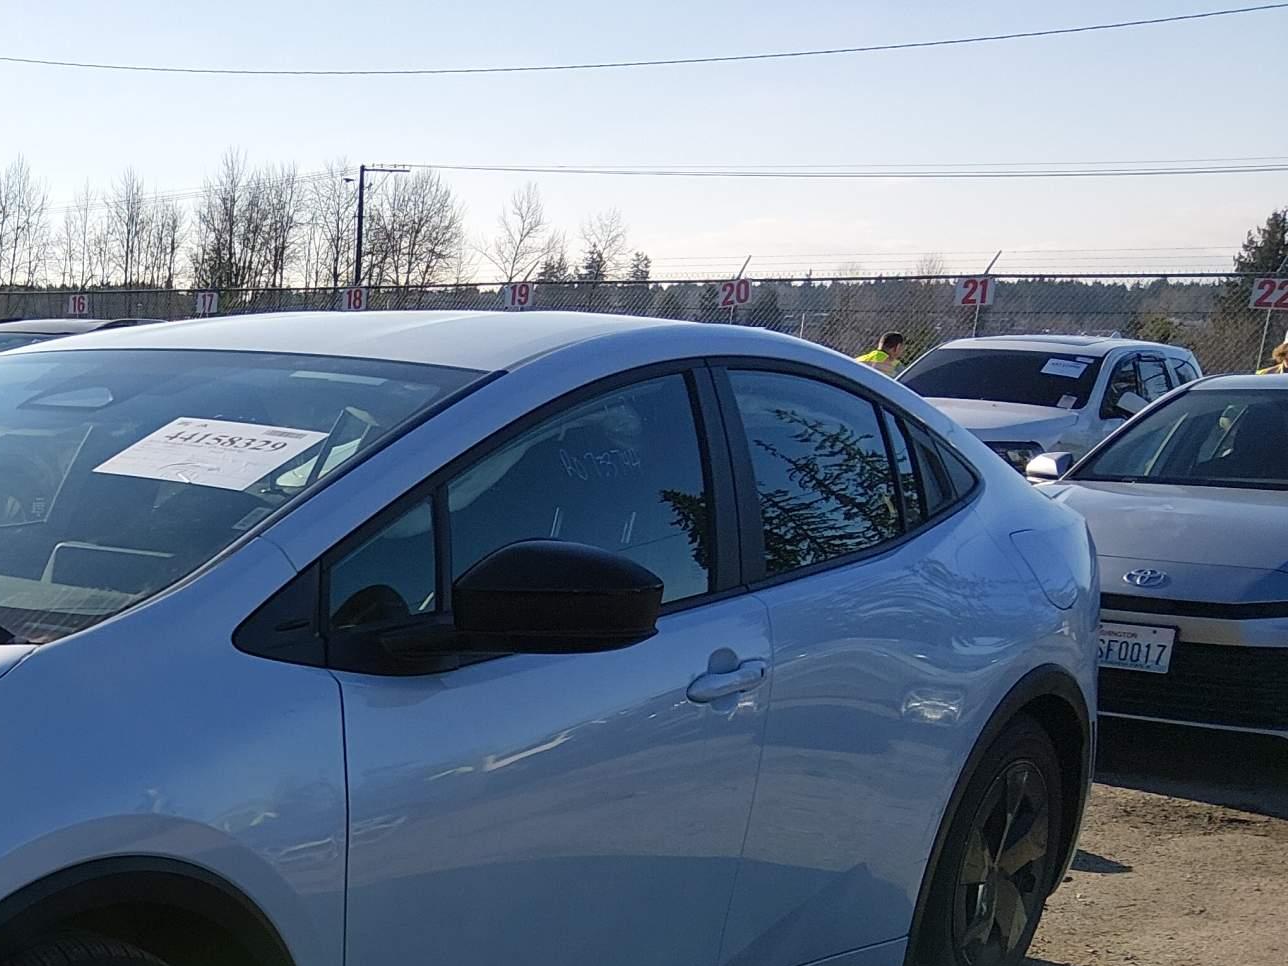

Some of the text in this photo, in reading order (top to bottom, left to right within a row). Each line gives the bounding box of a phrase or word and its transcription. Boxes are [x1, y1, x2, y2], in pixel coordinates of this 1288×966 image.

[201, 293, 214, 311] 17
[346, 289, 361, 309] 18
[511, 284, 529, 306] 19
[721, 280, 749, 306] 20
[962, 279, 988, 305] 21
[1255, 279, 1288, 308] 22
[72, 296, 85, 312] 16
[165, 431, 289, 452] 44158329
